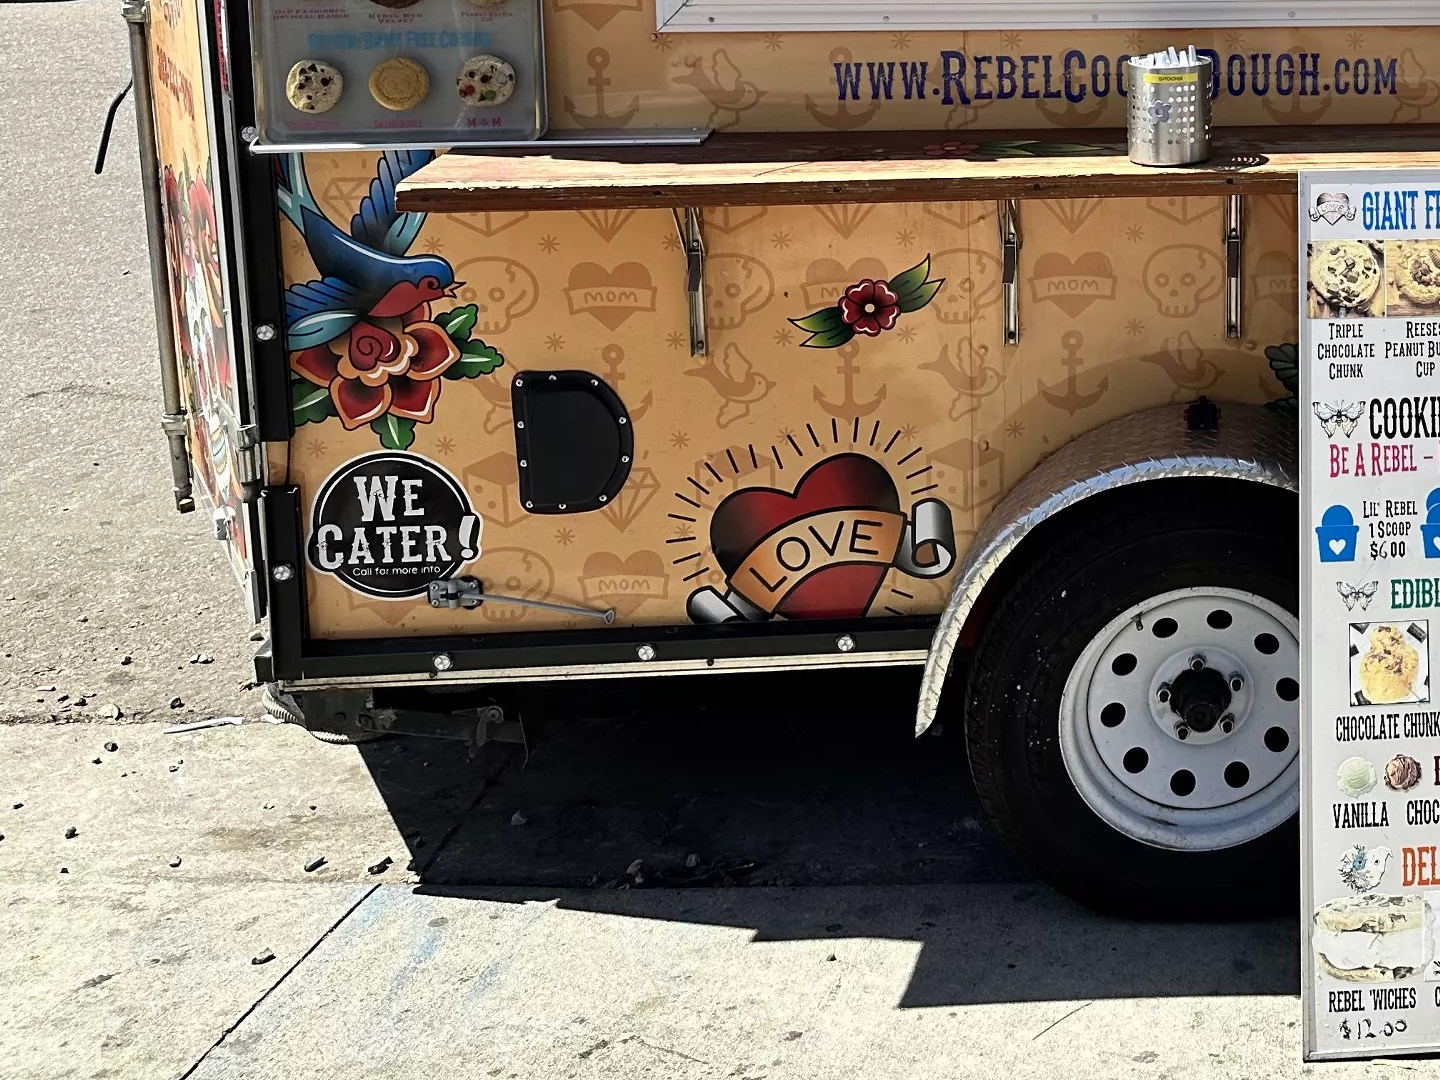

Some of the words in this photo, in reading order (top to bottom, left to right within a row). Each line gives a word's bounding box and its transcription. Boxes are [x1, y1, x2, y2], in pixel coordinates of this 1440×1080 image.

[1362, 190, 1418, 230] GIANT
[584, 291, 638, 304] MOM
[1328, 323, 1364, 339] TRIPLE
[1317, 343, 1375, 359] CHOCOLATE
[1385, 342, 1425, 358] PEANUT
[1329, 363, 1363, 380] CHUNK
[1416, 361, 1435, 377] CUP
[1330, 444, 1349, 478] BE
[1355, 443, 1367, 476] A
[1371, 442, 1417, 475] REBEL
[353, 475, 425, 521] WE
[1363, 500, 1380, 516] LIL'
[1385, 500, 1418, 516] REBEL
[1377, 522, 1411, 537] SCOOP
[317, 516, 476, 570] CATER!
[750, 520, 882, 592] LOVE
[352, 566, 371, 576] Call
[374, 566, 389, 576] for
[392, 566, 417, 575] more
[421, 564, 441, 574] info
[1336, 714, 1399, 742] CHOCOLATE
[1333, 802, 1389, 829] VANILLA
[1329, 990, 1366, 1013] REBEL
[1369, 988, 1416, 1012] 'WICHES
